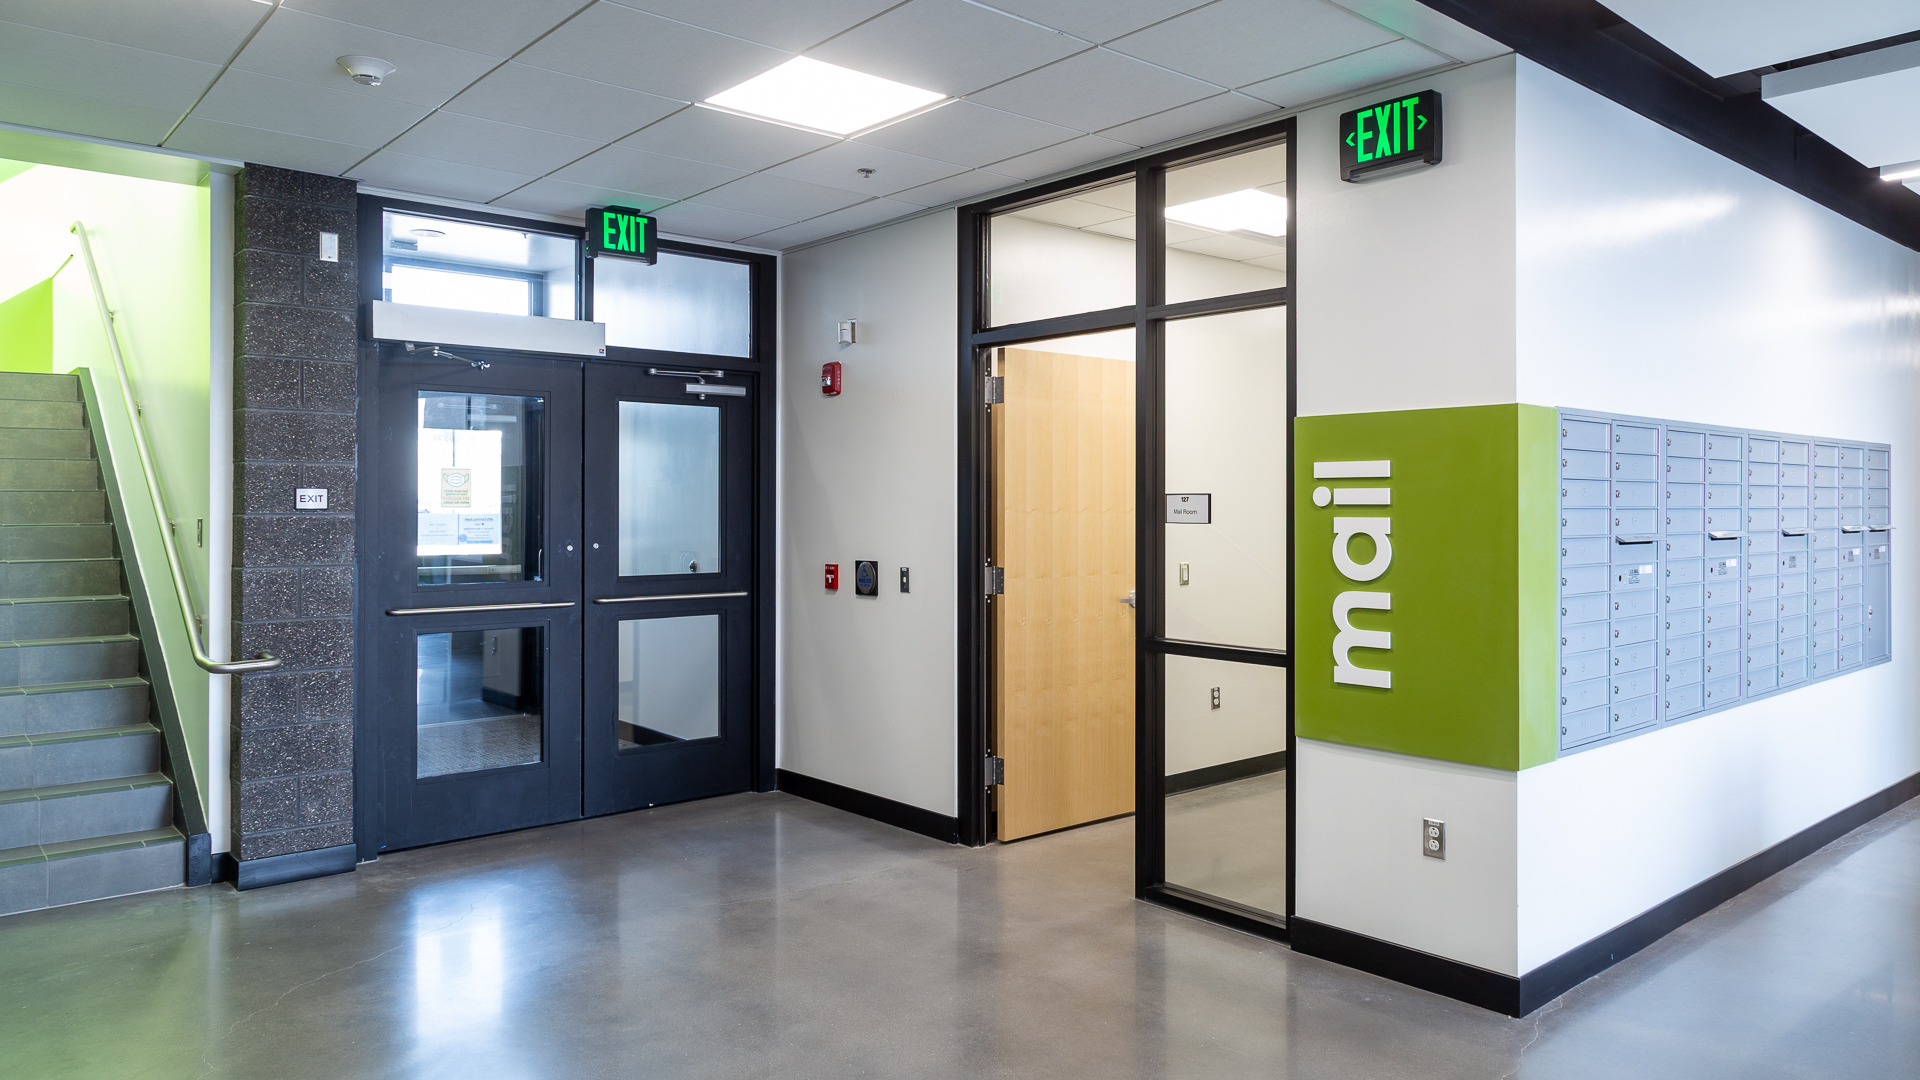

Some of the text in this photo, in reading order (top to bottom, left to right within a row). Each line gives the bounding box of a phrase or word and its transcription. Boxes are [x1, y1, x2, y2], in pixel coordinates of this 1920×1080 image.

[1357, 96, 1419, 163] EXIT
[603, 211, 648, 254] EXIT
[299, 494, 324, 503] EXIT
[1312, 459, 1392, 689] mail
